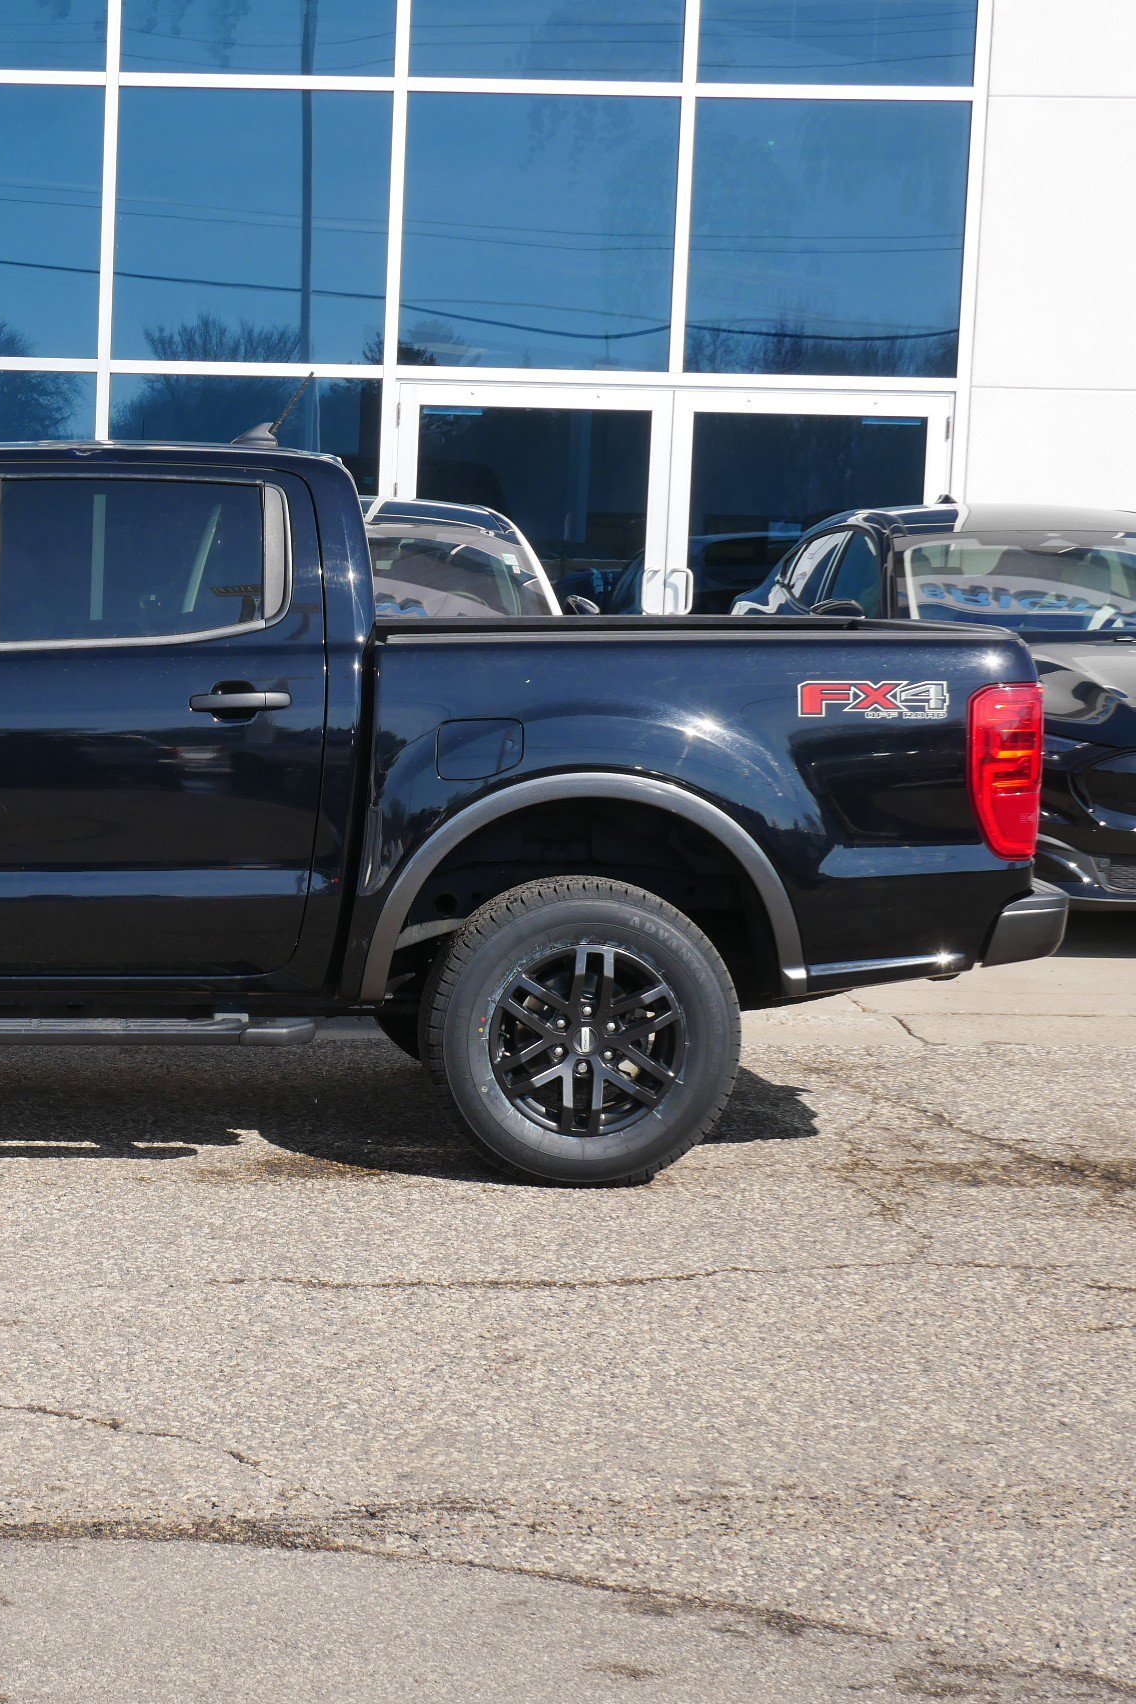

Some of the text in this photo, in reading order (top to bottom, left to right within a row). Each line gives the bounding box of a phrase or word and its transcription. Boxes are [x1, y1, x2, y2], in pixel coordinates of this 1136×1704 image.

[797, 680, 949, 717] FX4
[865, 711, 948, 719] OFF ROAD
[628, 916, 707, 985] ADVANTA
